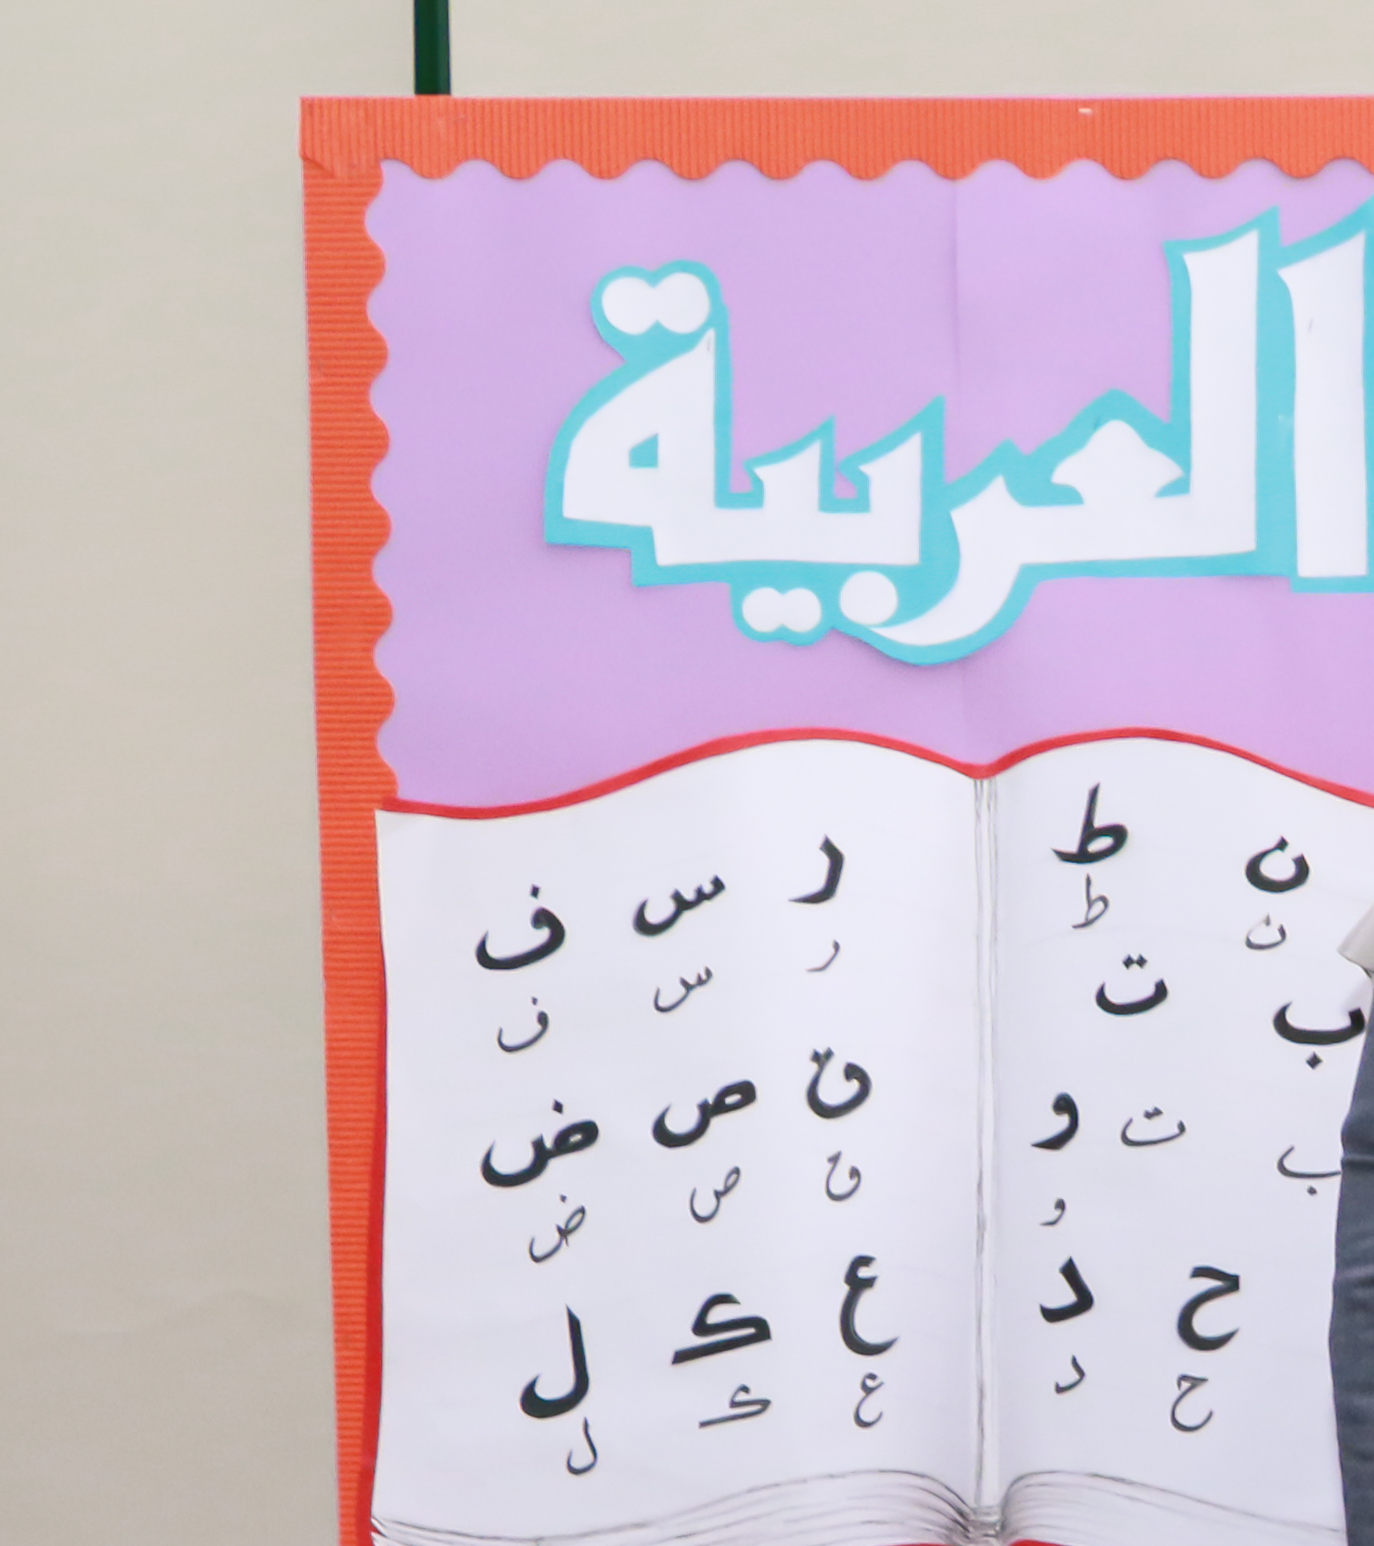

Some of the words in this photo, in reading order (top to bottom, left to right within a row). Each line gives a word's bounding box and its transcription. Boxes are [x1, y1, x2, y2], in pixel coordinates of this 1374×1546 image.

[1050, 781, 1130, 867] ط
[787, 834, 847, 906] ر
[1243, 834, 1312, 896] ن
[473, 883, 568, 973] ف
[631, 873, 727, 939] س
[1070, 872, 1111, 931] ط
[1243, 913, 1288, 952] ن
[806, 939, 842, 974] ر
[1093, 952, 1170, 1018] ت
[652, 965, 714, 1015] س
[495, 995, 551, 1055] ف
[1271, 1000, 1366, 1074] ب
[650, 1078, 759, 1151] ص
[804, 1045, 874, 1122] ق
[479, 1098, 601, 1190] ض
[1029, 1091, 1081, 1153] و
[1119, 1105, 1188, 1149] ت
[688, 1165, 742, 1226] ص
[824, 1149, 863, 1204] ق
[1275, 1145, 1342, 1198] ب
[527, 1193, 588, 1265] ض
[1039, 1197, 1068, 1228] و
[838, 1253, 900, 1358] ع
[1038, 1254, 1096, 1325] د
[1175, 1264, 1242, 1354] ح
[518, 1304, 592, 1426] ل
[1053, 1353, 1087, 1396] د
[852, 1371, 886, 1430] ع
[1169, 1372, 1215, 1434] ح
[565, 1415, 600, 1478] ل
